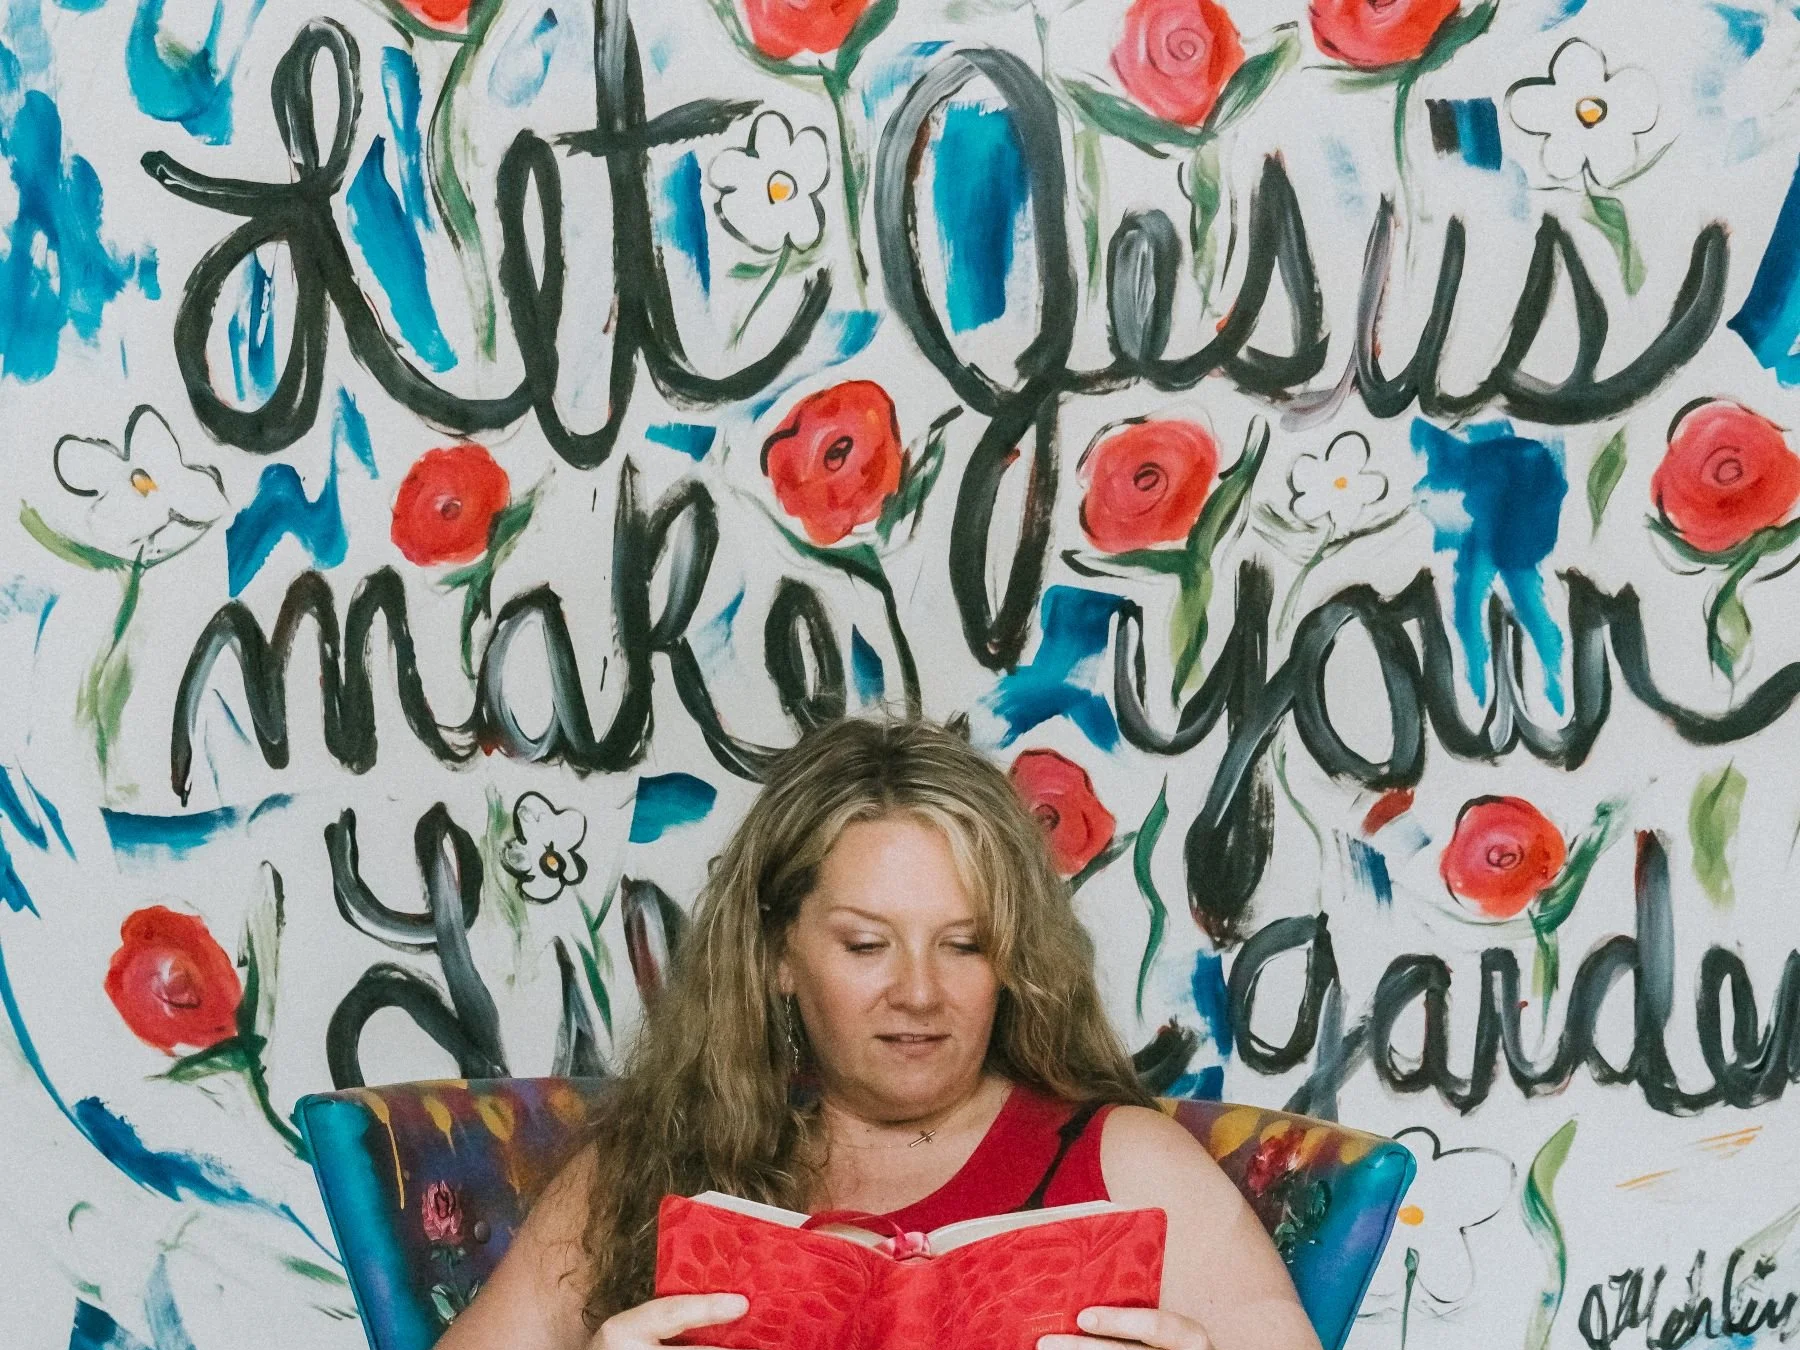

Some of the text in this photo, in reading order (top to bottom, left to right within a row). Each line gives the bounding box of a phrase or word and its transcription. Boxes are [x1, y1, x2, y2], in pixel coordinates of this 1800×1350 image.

[140, 0, 1732, 671] Let Jesus
[172, 452, 848, 807] make
[1112, 558, 1800, 951] your
